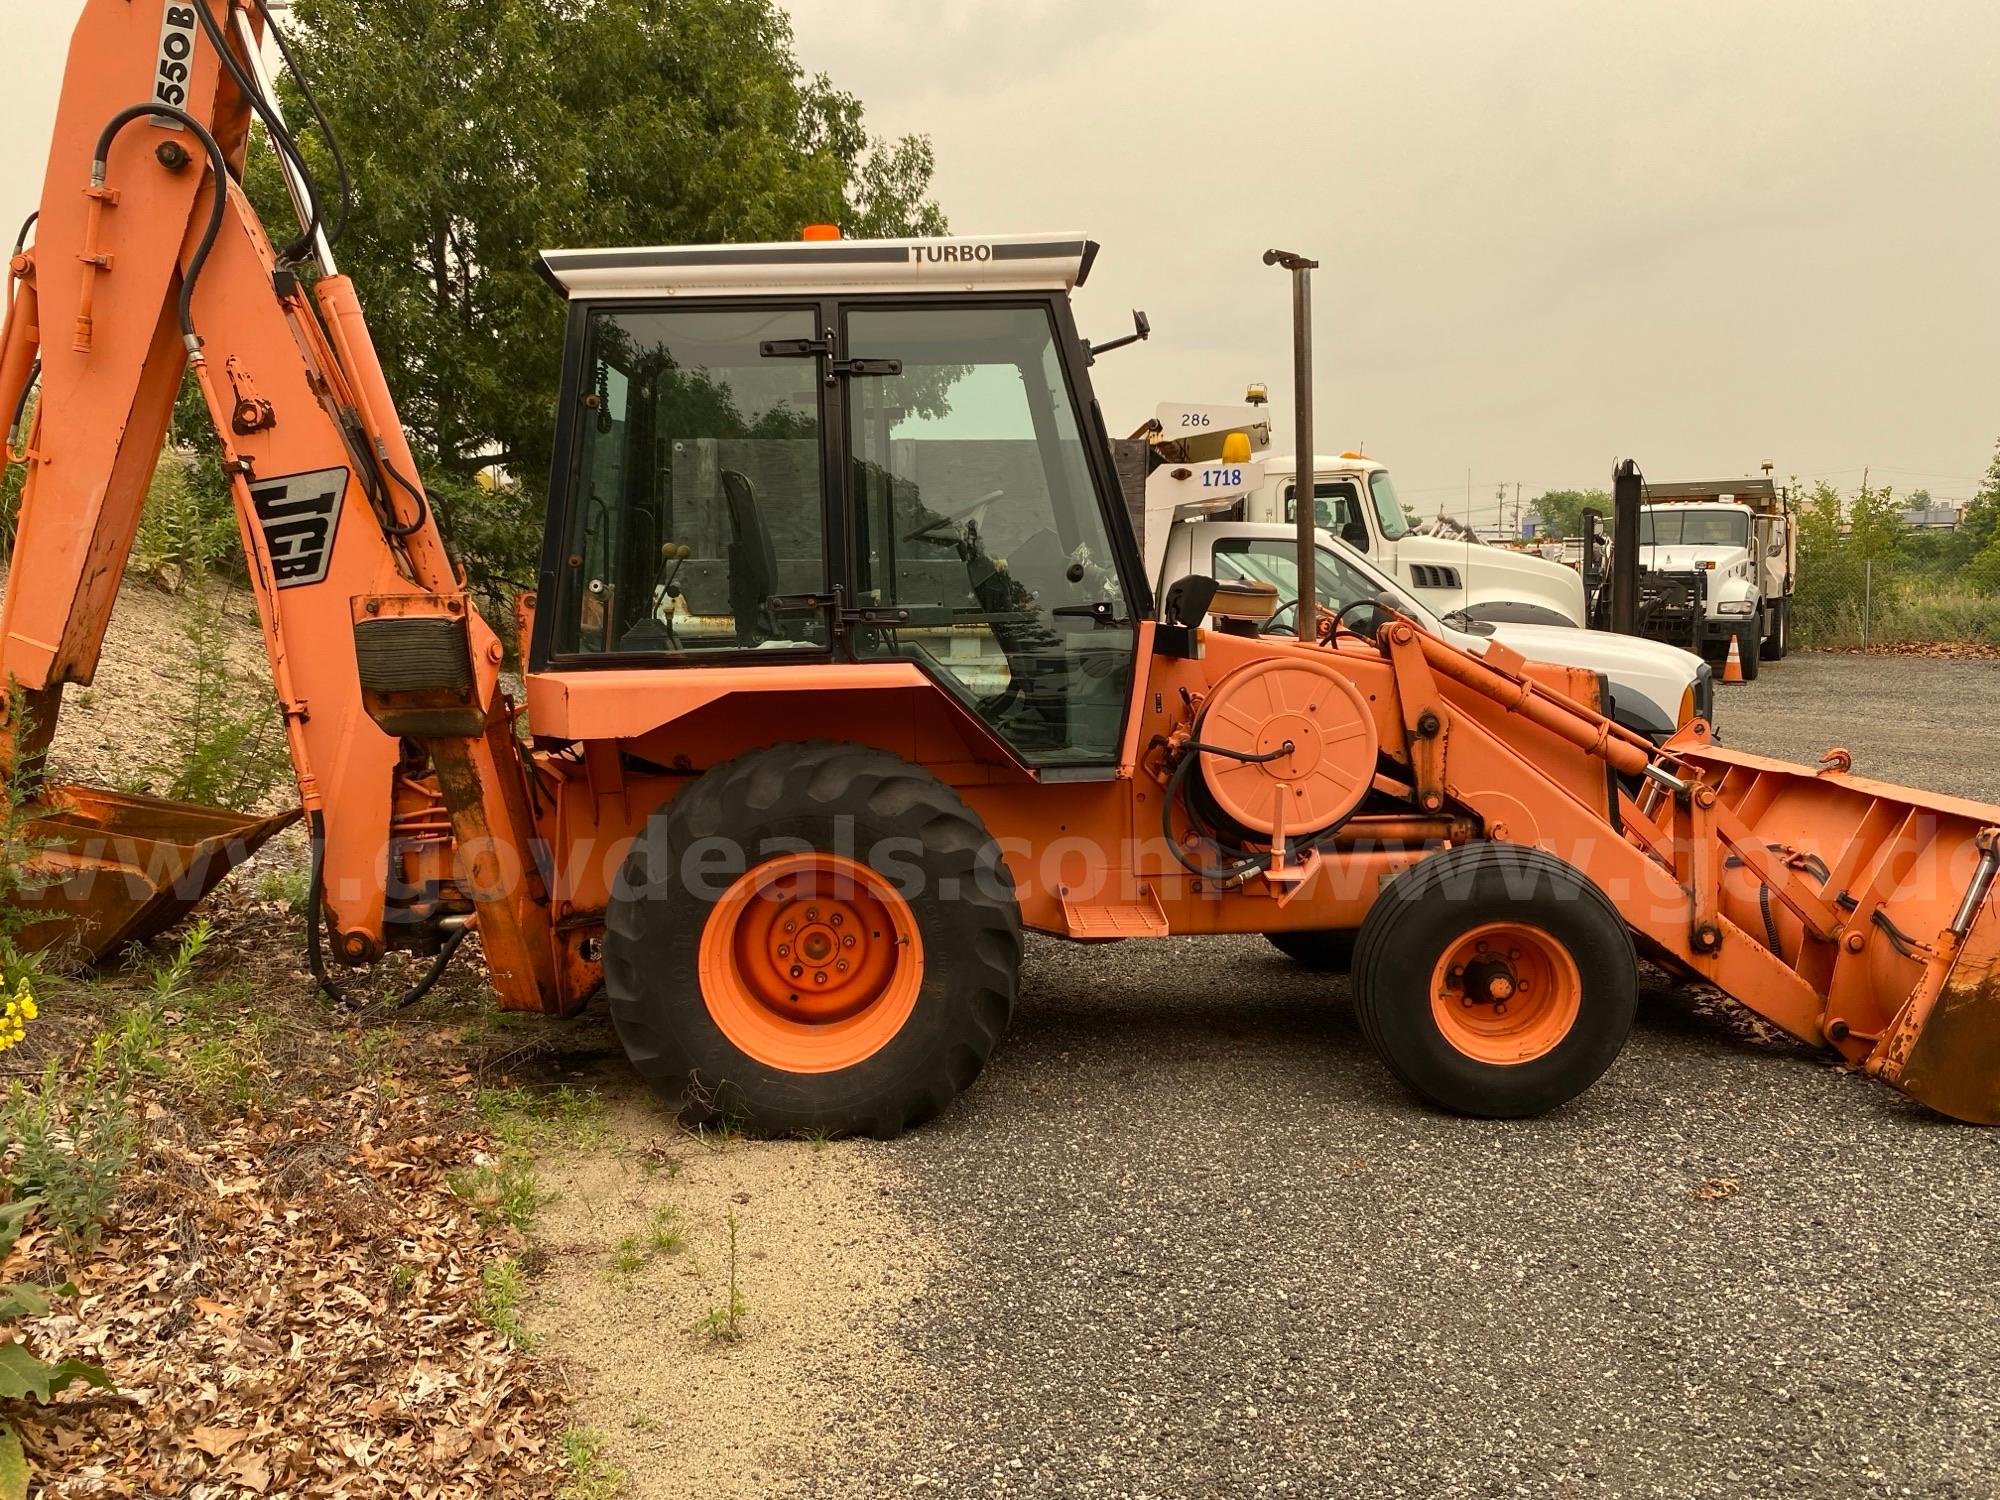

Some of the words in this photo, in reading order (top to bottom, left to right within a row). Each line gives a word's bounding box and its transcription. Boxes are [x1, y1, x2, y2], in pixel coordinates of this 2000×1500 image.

[155, 6, 195, 117] 550B
[911, 244, 991, 263] TURBO
[1181, 413, 1210, 427] 286
[1202, 469, 1242, 487] 1718
[250, 485, 337, 581] JCB
